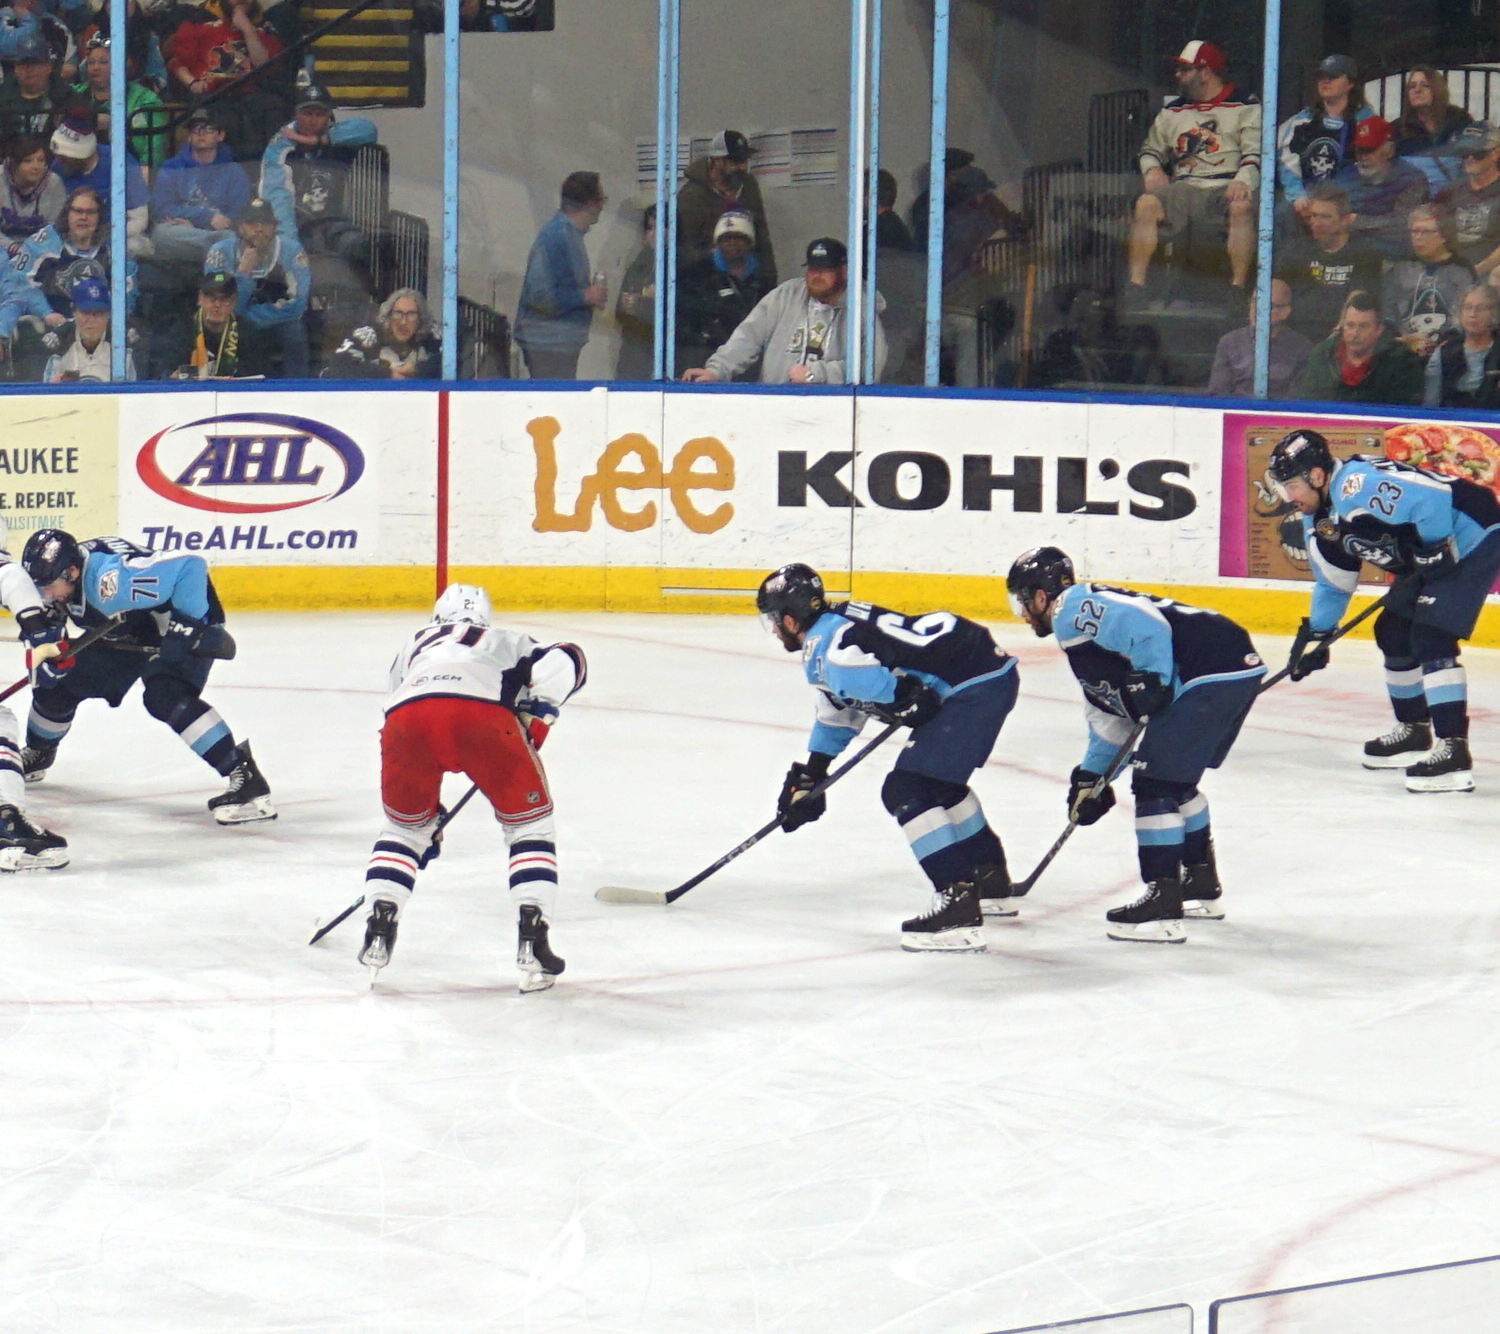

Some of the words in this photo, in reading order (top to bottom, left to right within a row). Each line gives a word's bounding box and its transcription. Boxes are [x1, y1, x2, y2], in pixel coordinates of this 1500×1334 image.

[177, 434, 324, 486] AHL
[526, 414, 736, 535] Lee
[15, 490, 80, 510] REPEAT.
[777, 450, 1199, 522] KOHL'S
[1369, 481, 1402, 517] 23
[3, 514, 66, 530] VISITMKE
[142, 524, 358, 551] TheAHL.com
[131, 574, 160, 604] 71
[1073, 598, 1105, 634] 52
